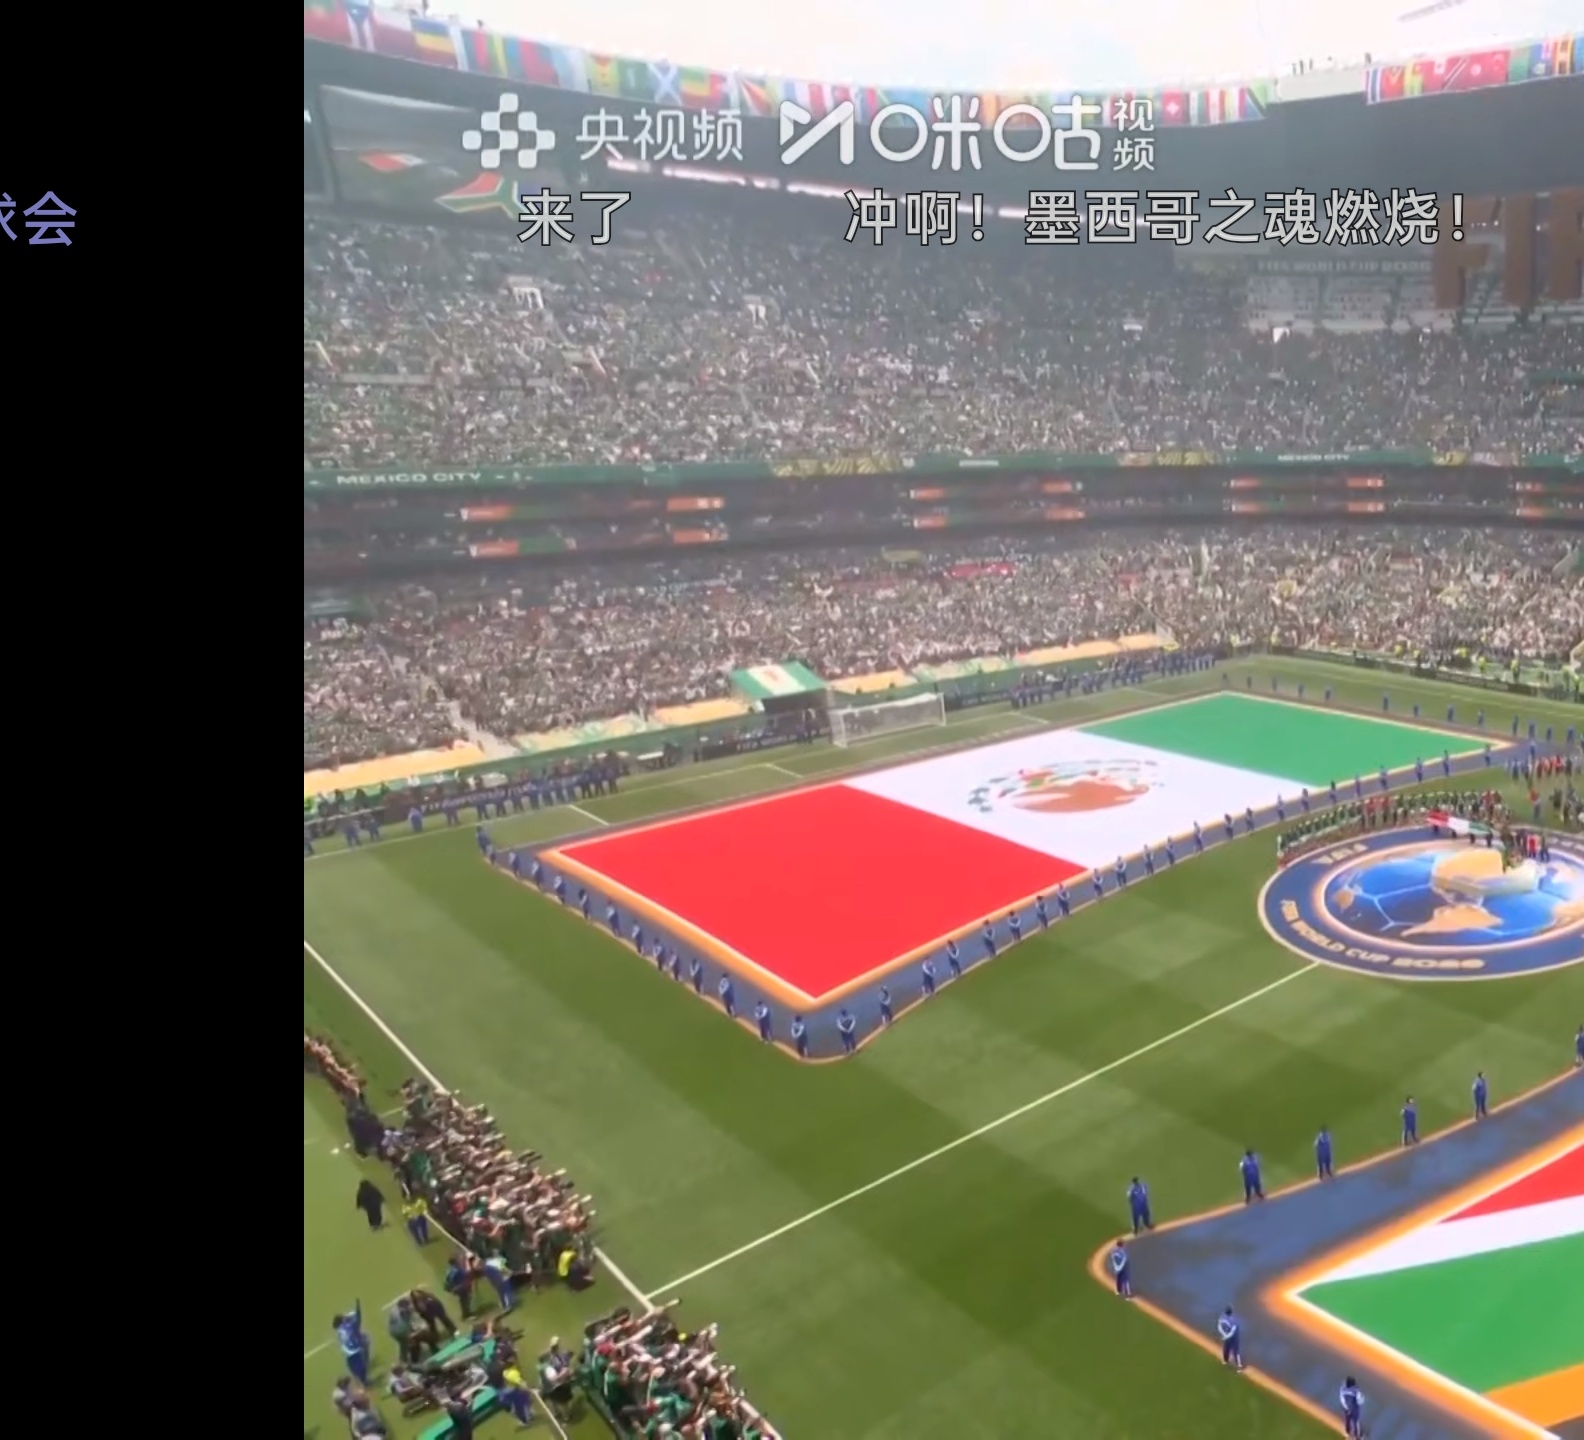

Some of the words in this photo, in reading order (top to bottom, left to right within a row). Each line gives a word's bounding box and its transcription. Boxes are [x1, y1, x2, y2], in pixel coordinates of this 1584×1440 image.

[1324, 454, 1349, 462] CITY
[336, 472, 427, 485] MEXICO
[432, 471, 481, 483] CITY
[1290, 919, 1347, 953] WORLD
[1345, 947, 1391, 963] CUP
